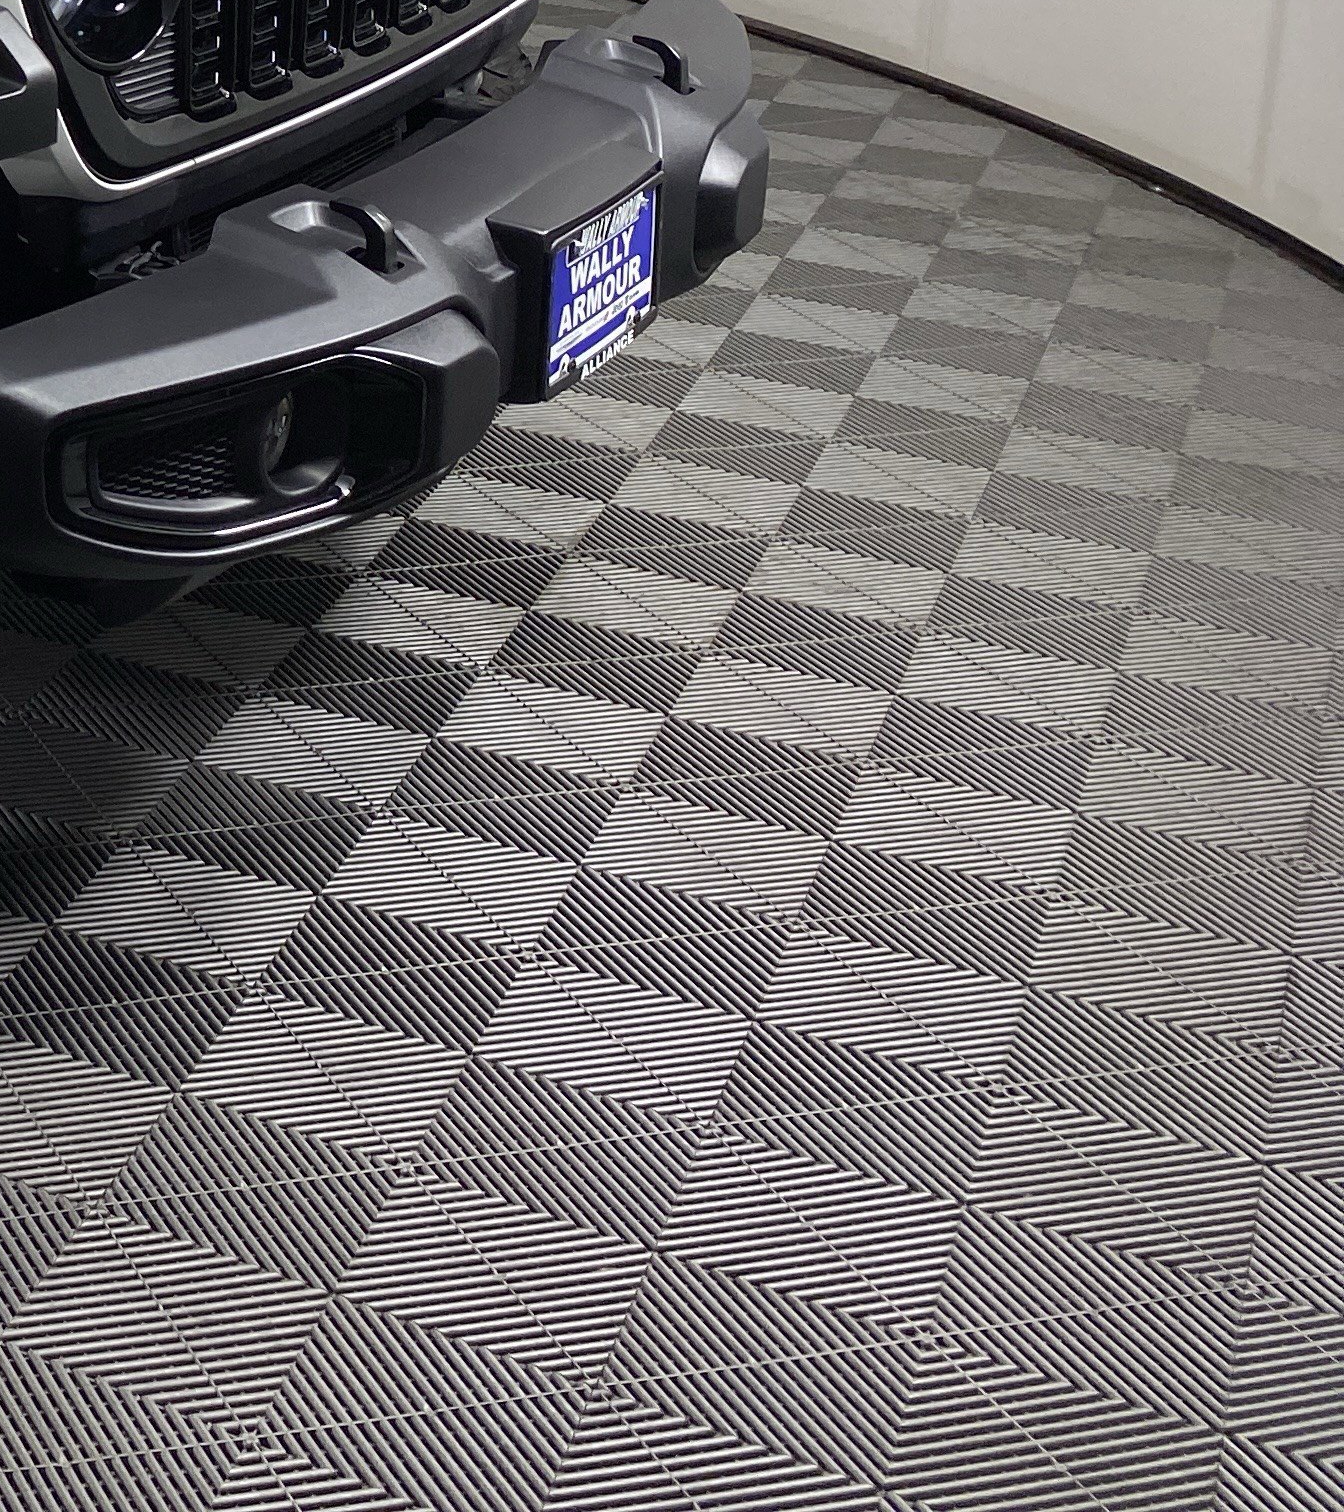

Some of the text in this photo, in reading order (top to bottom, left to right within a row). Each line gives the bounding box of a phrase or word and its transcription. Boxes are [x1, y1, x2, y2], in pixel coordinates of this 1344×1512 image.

[570, 224, 635, 295] WALLY
[557, 254, 641, 339] ARMOUR
[580, 329, 635, 381] ALLIANCE
